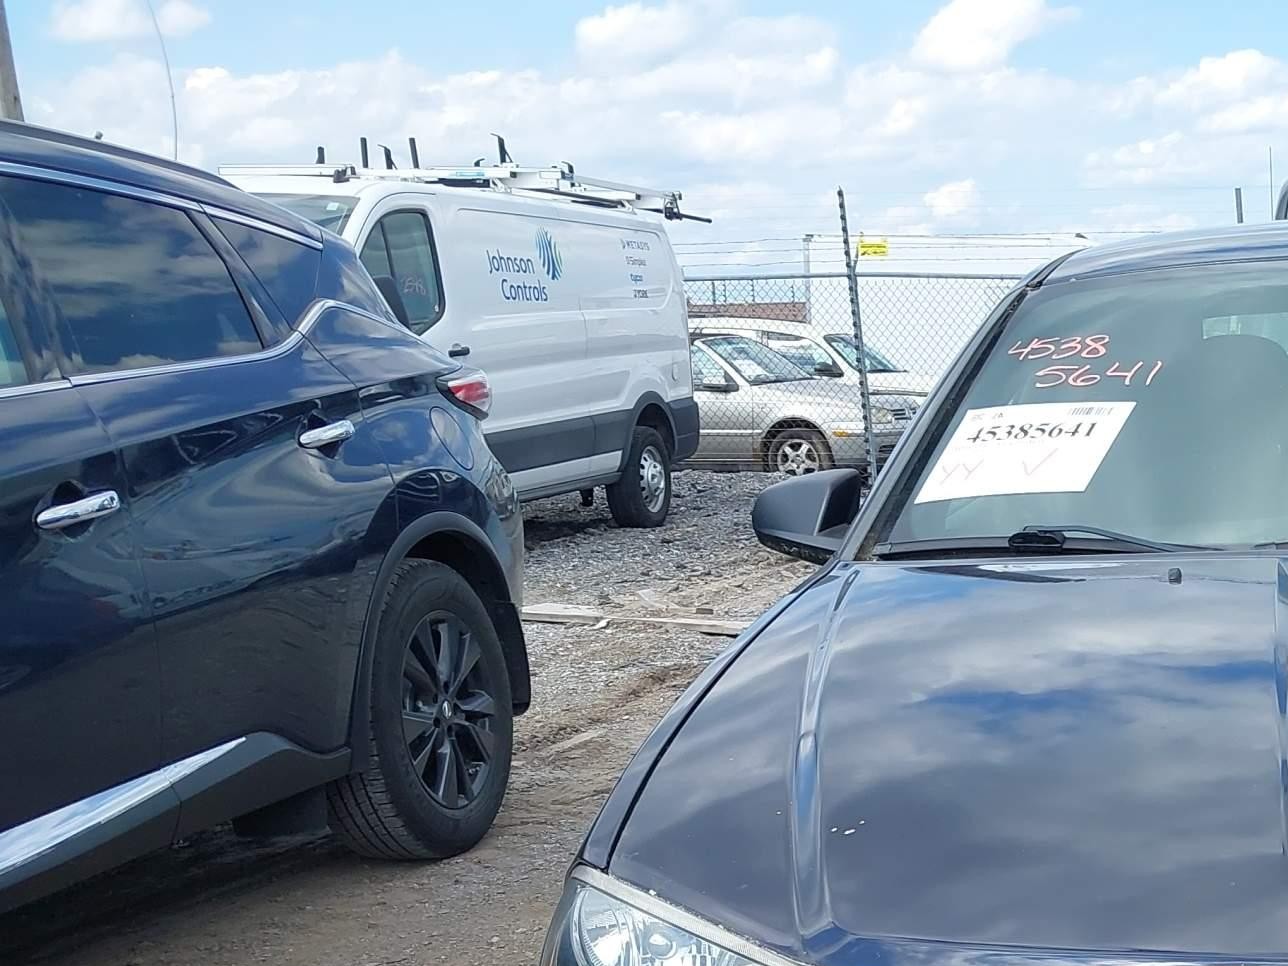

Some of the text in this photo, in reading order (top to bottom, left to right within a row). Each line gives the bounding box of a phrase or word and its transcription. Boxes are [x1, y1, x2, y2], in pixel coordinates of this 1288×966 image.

[486, 248, 536, 275] Johnson
[500, 278, 549, 303] Controls
[1007, 334, 1110, 361] 4538
[1034, 359, 1165, 389] 5641
[965, 421, 1099, 444] 45385641
